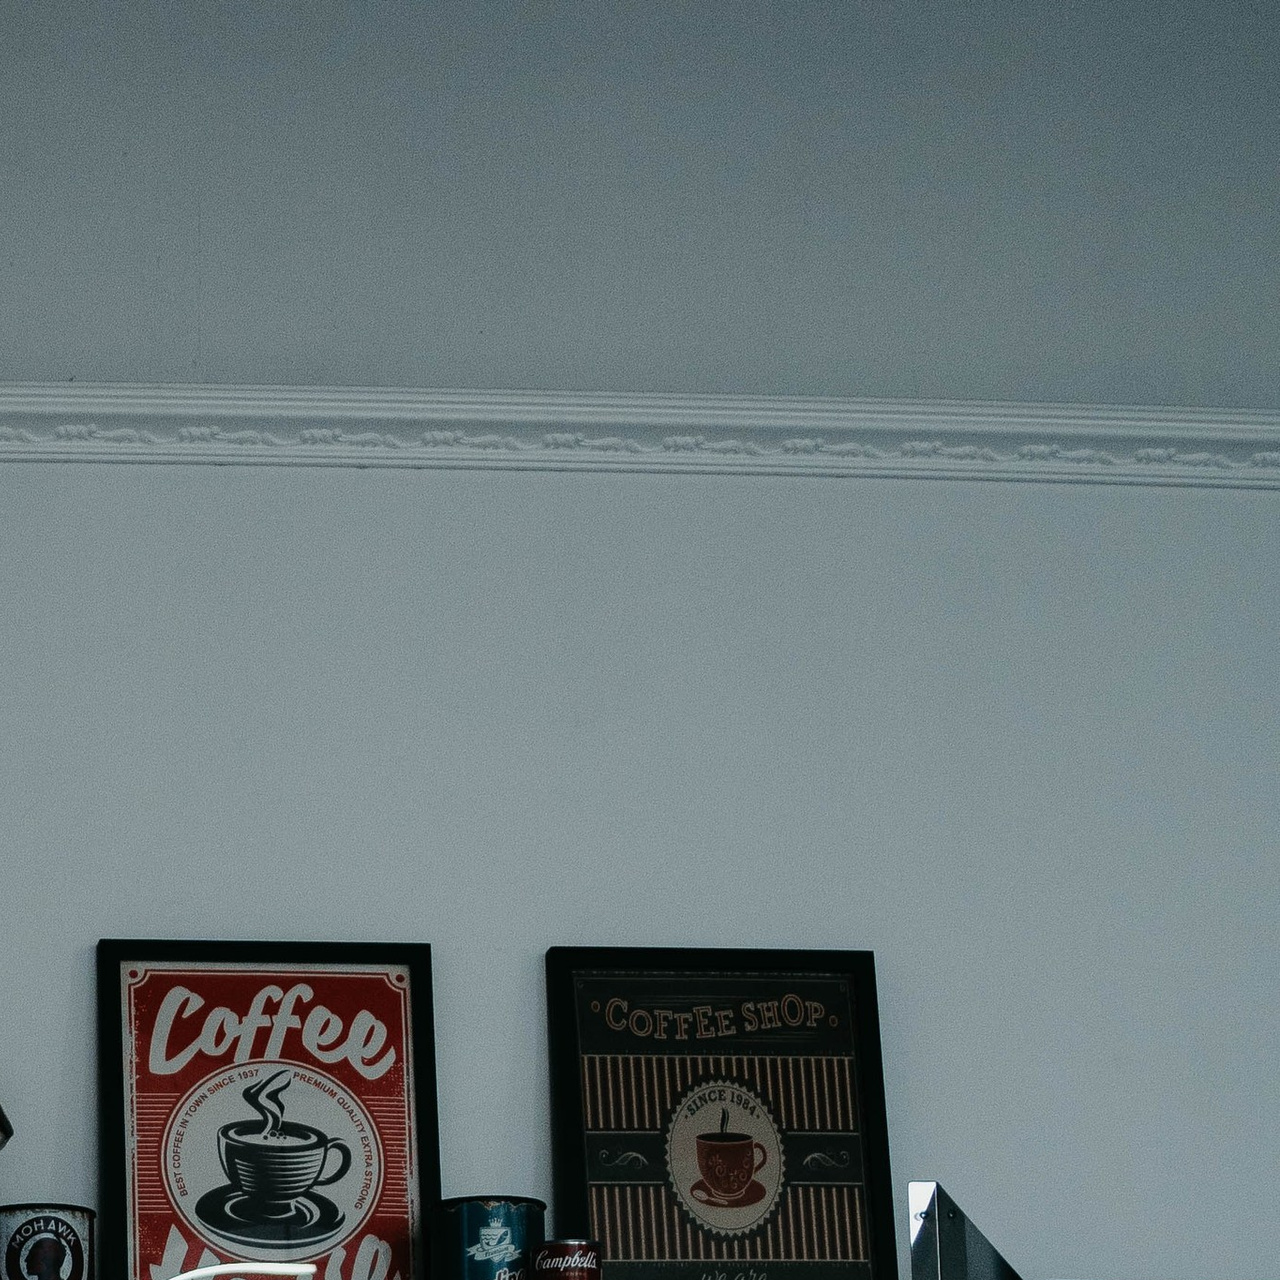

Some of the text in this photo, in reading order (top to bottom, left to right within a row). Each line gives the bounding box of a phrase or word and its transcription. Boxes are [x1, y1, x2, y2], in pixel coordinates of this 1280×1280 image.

[148, 983, 396, 1080] Coffee
[605, 993, 826, 1040] COFFEE SHOP
[172, 1069, 260, 1197] BEST COFFEE IN TOWN SINCE 1937
[687, 1089, 758, 1116] SINCE 1984
[293, 1071, 373, 1210] PREMIUM QUALITY EXTRA STRONG
[11, 1219, 78, 1249] MOHAWK
